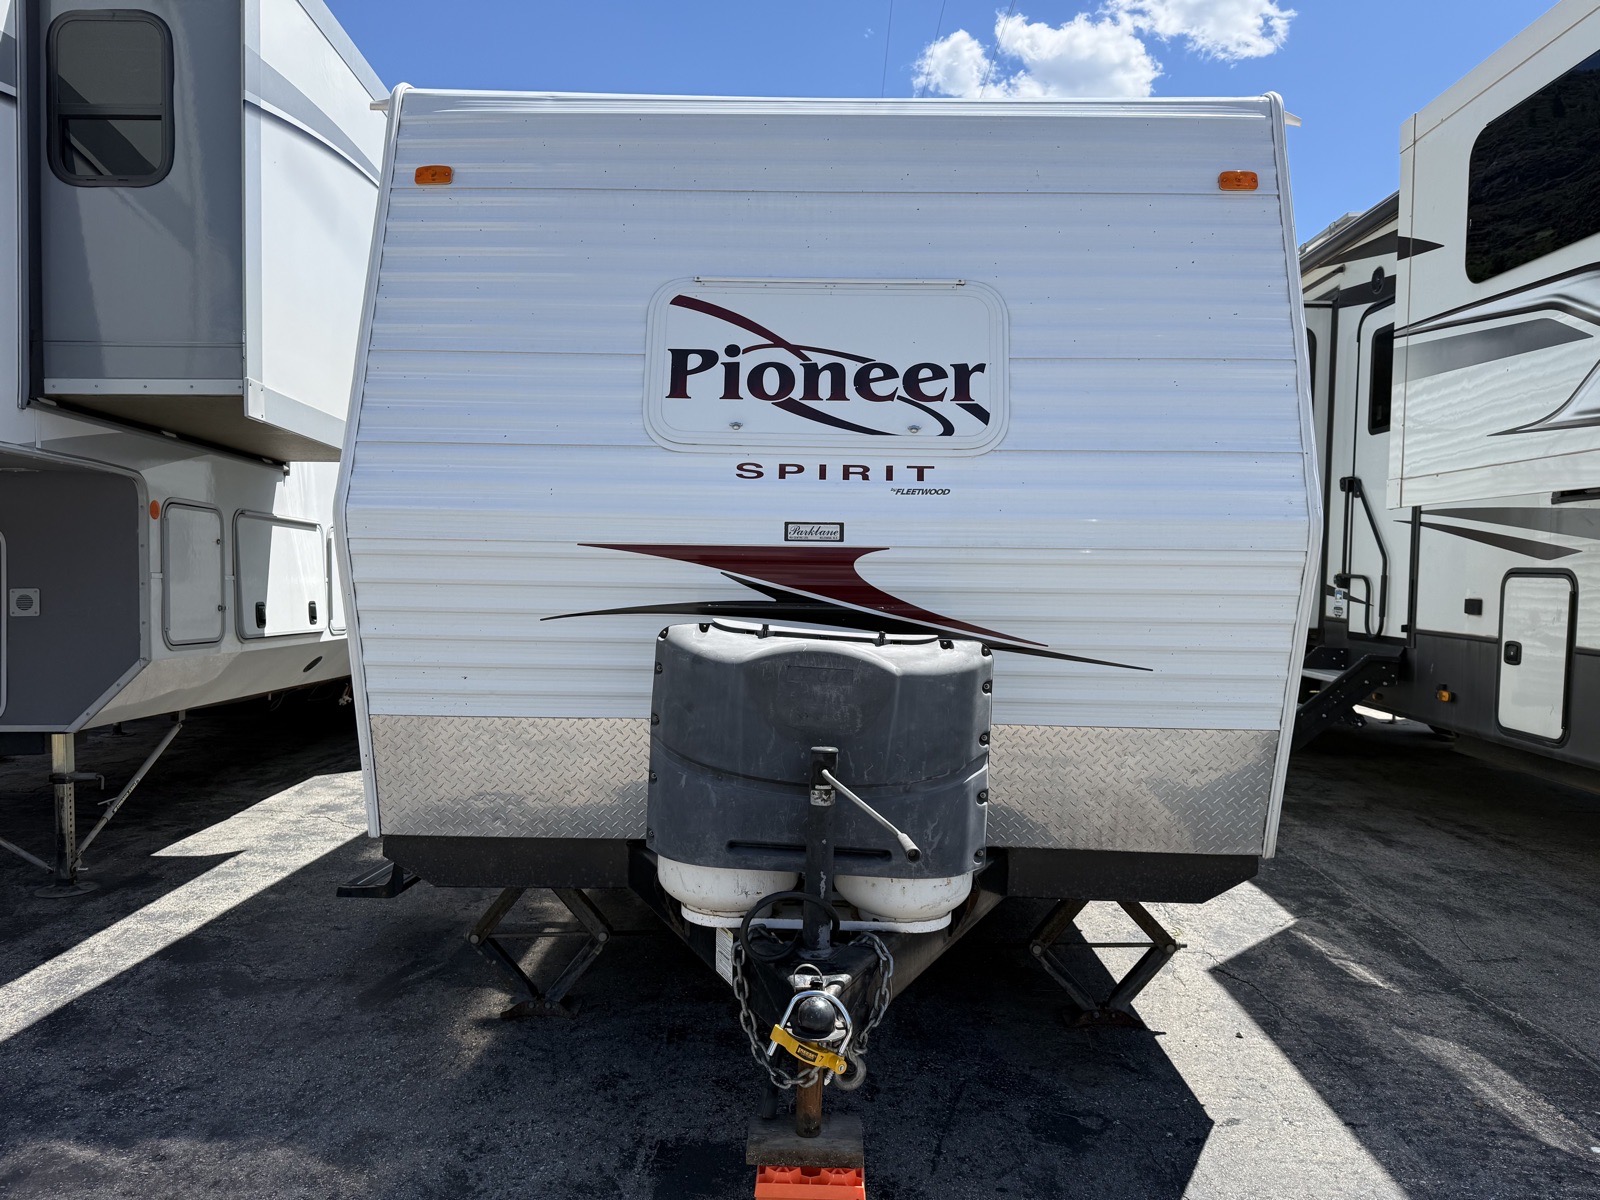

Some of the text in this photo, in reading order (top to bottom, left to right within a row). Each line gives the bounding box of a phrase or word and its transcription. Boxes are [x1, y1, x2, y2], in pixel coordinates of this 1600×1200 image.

[665, 344, 987, 402] Pioneer
[735, 462, 935, 482] SPIRIT
[895, 488, 951, 496] FLEETWOOD
[788, 525, 839, 536] Parklane
